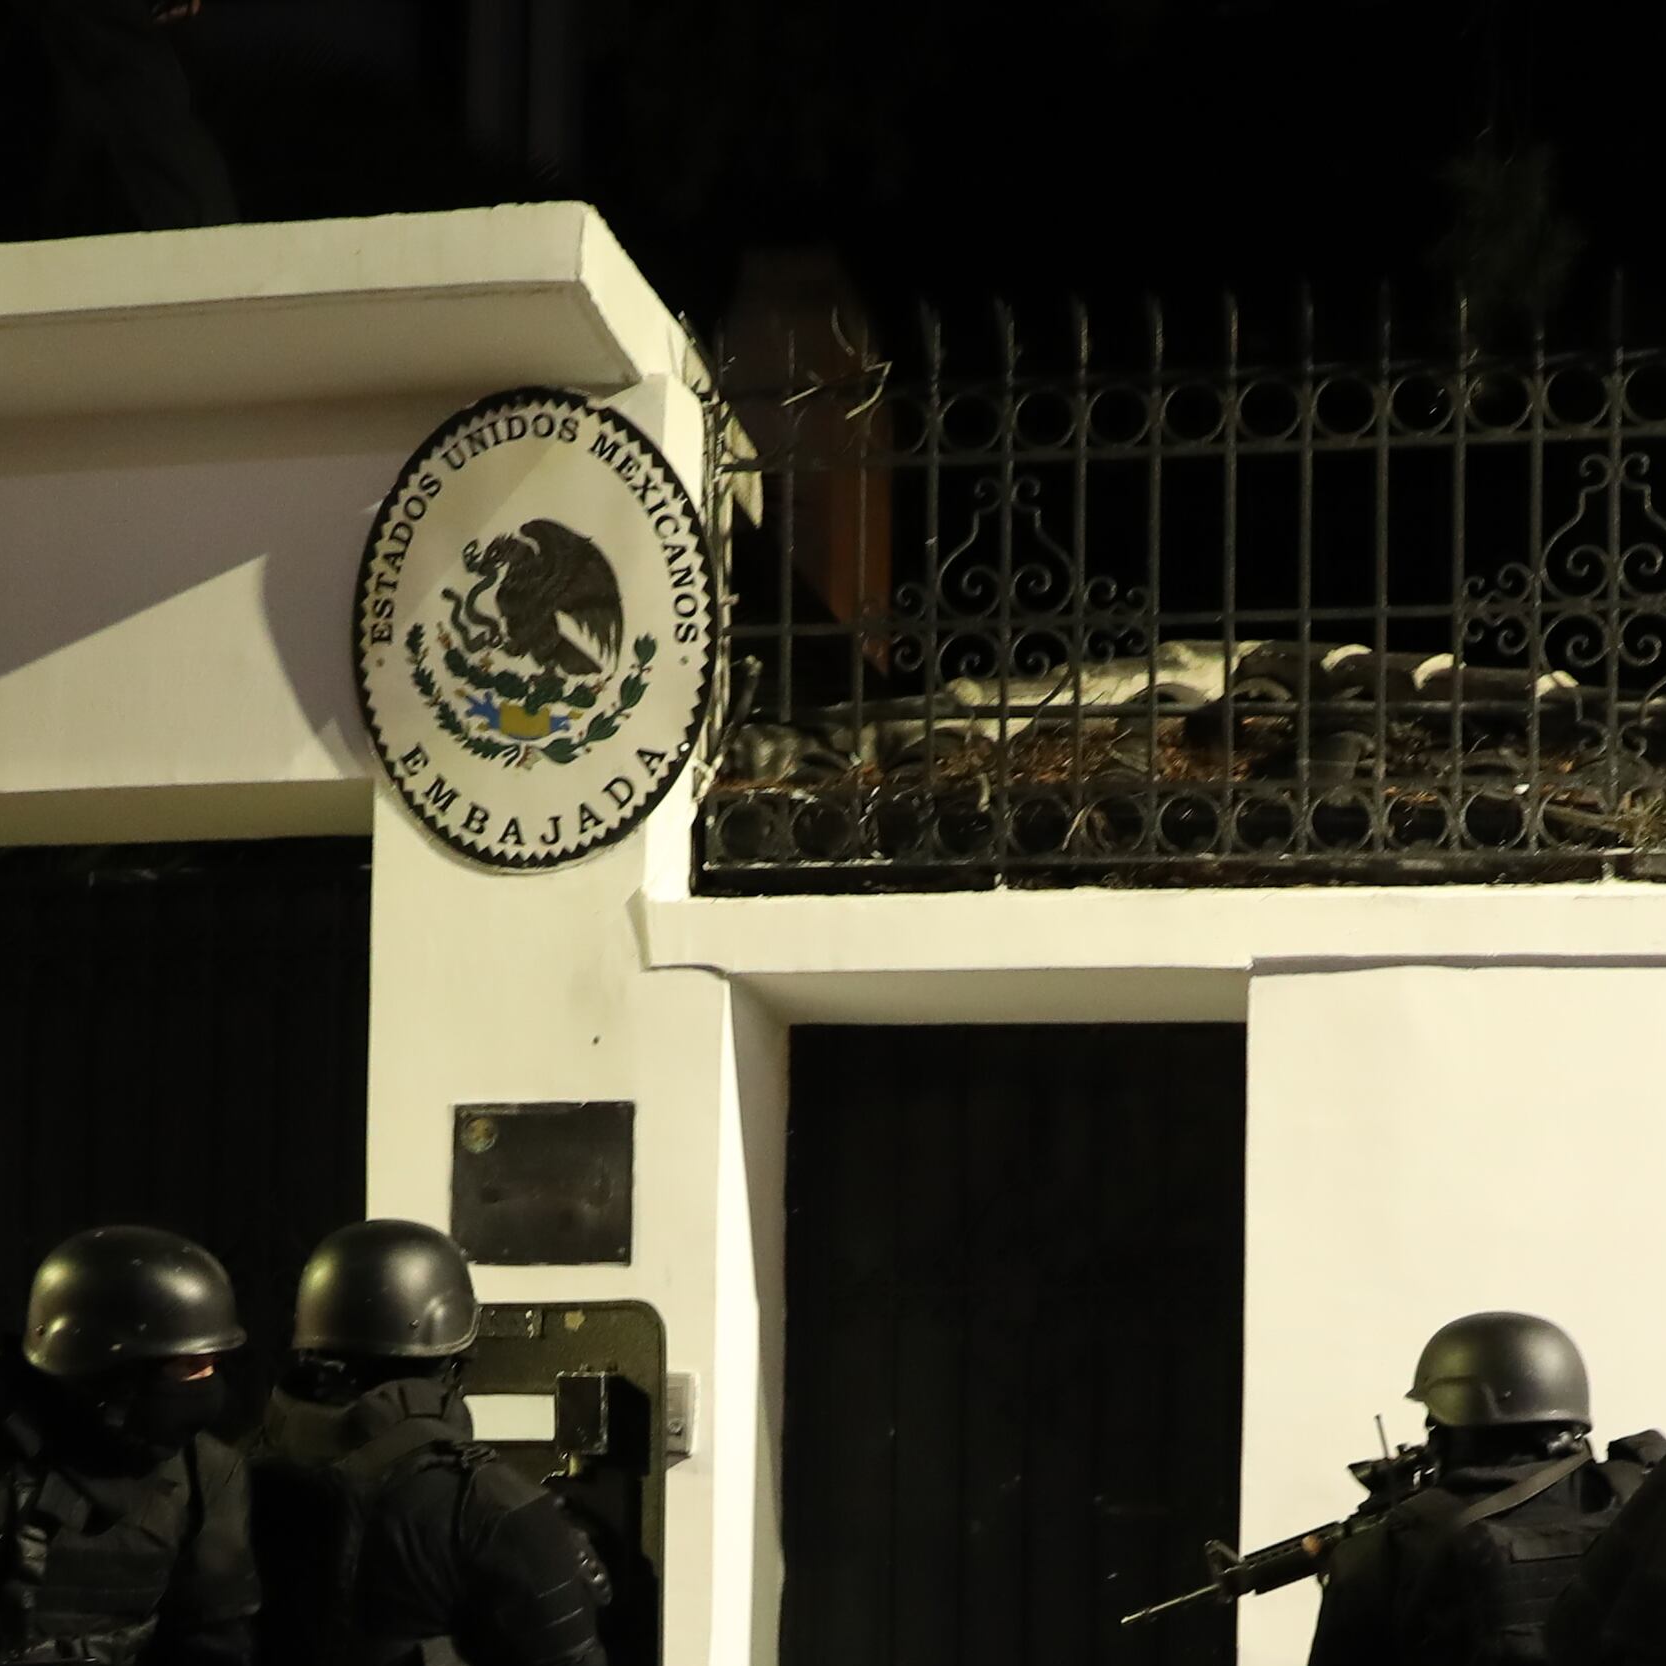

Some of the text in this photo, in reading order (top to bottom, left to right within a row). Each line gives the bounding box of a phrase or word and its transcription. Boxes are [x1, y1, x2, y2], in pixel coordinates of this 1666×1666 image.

[372, 414, 697, 645] ESTADOS UNIDOS MEXICANOS
[399, 744, 667, 846] EMBAJADA
